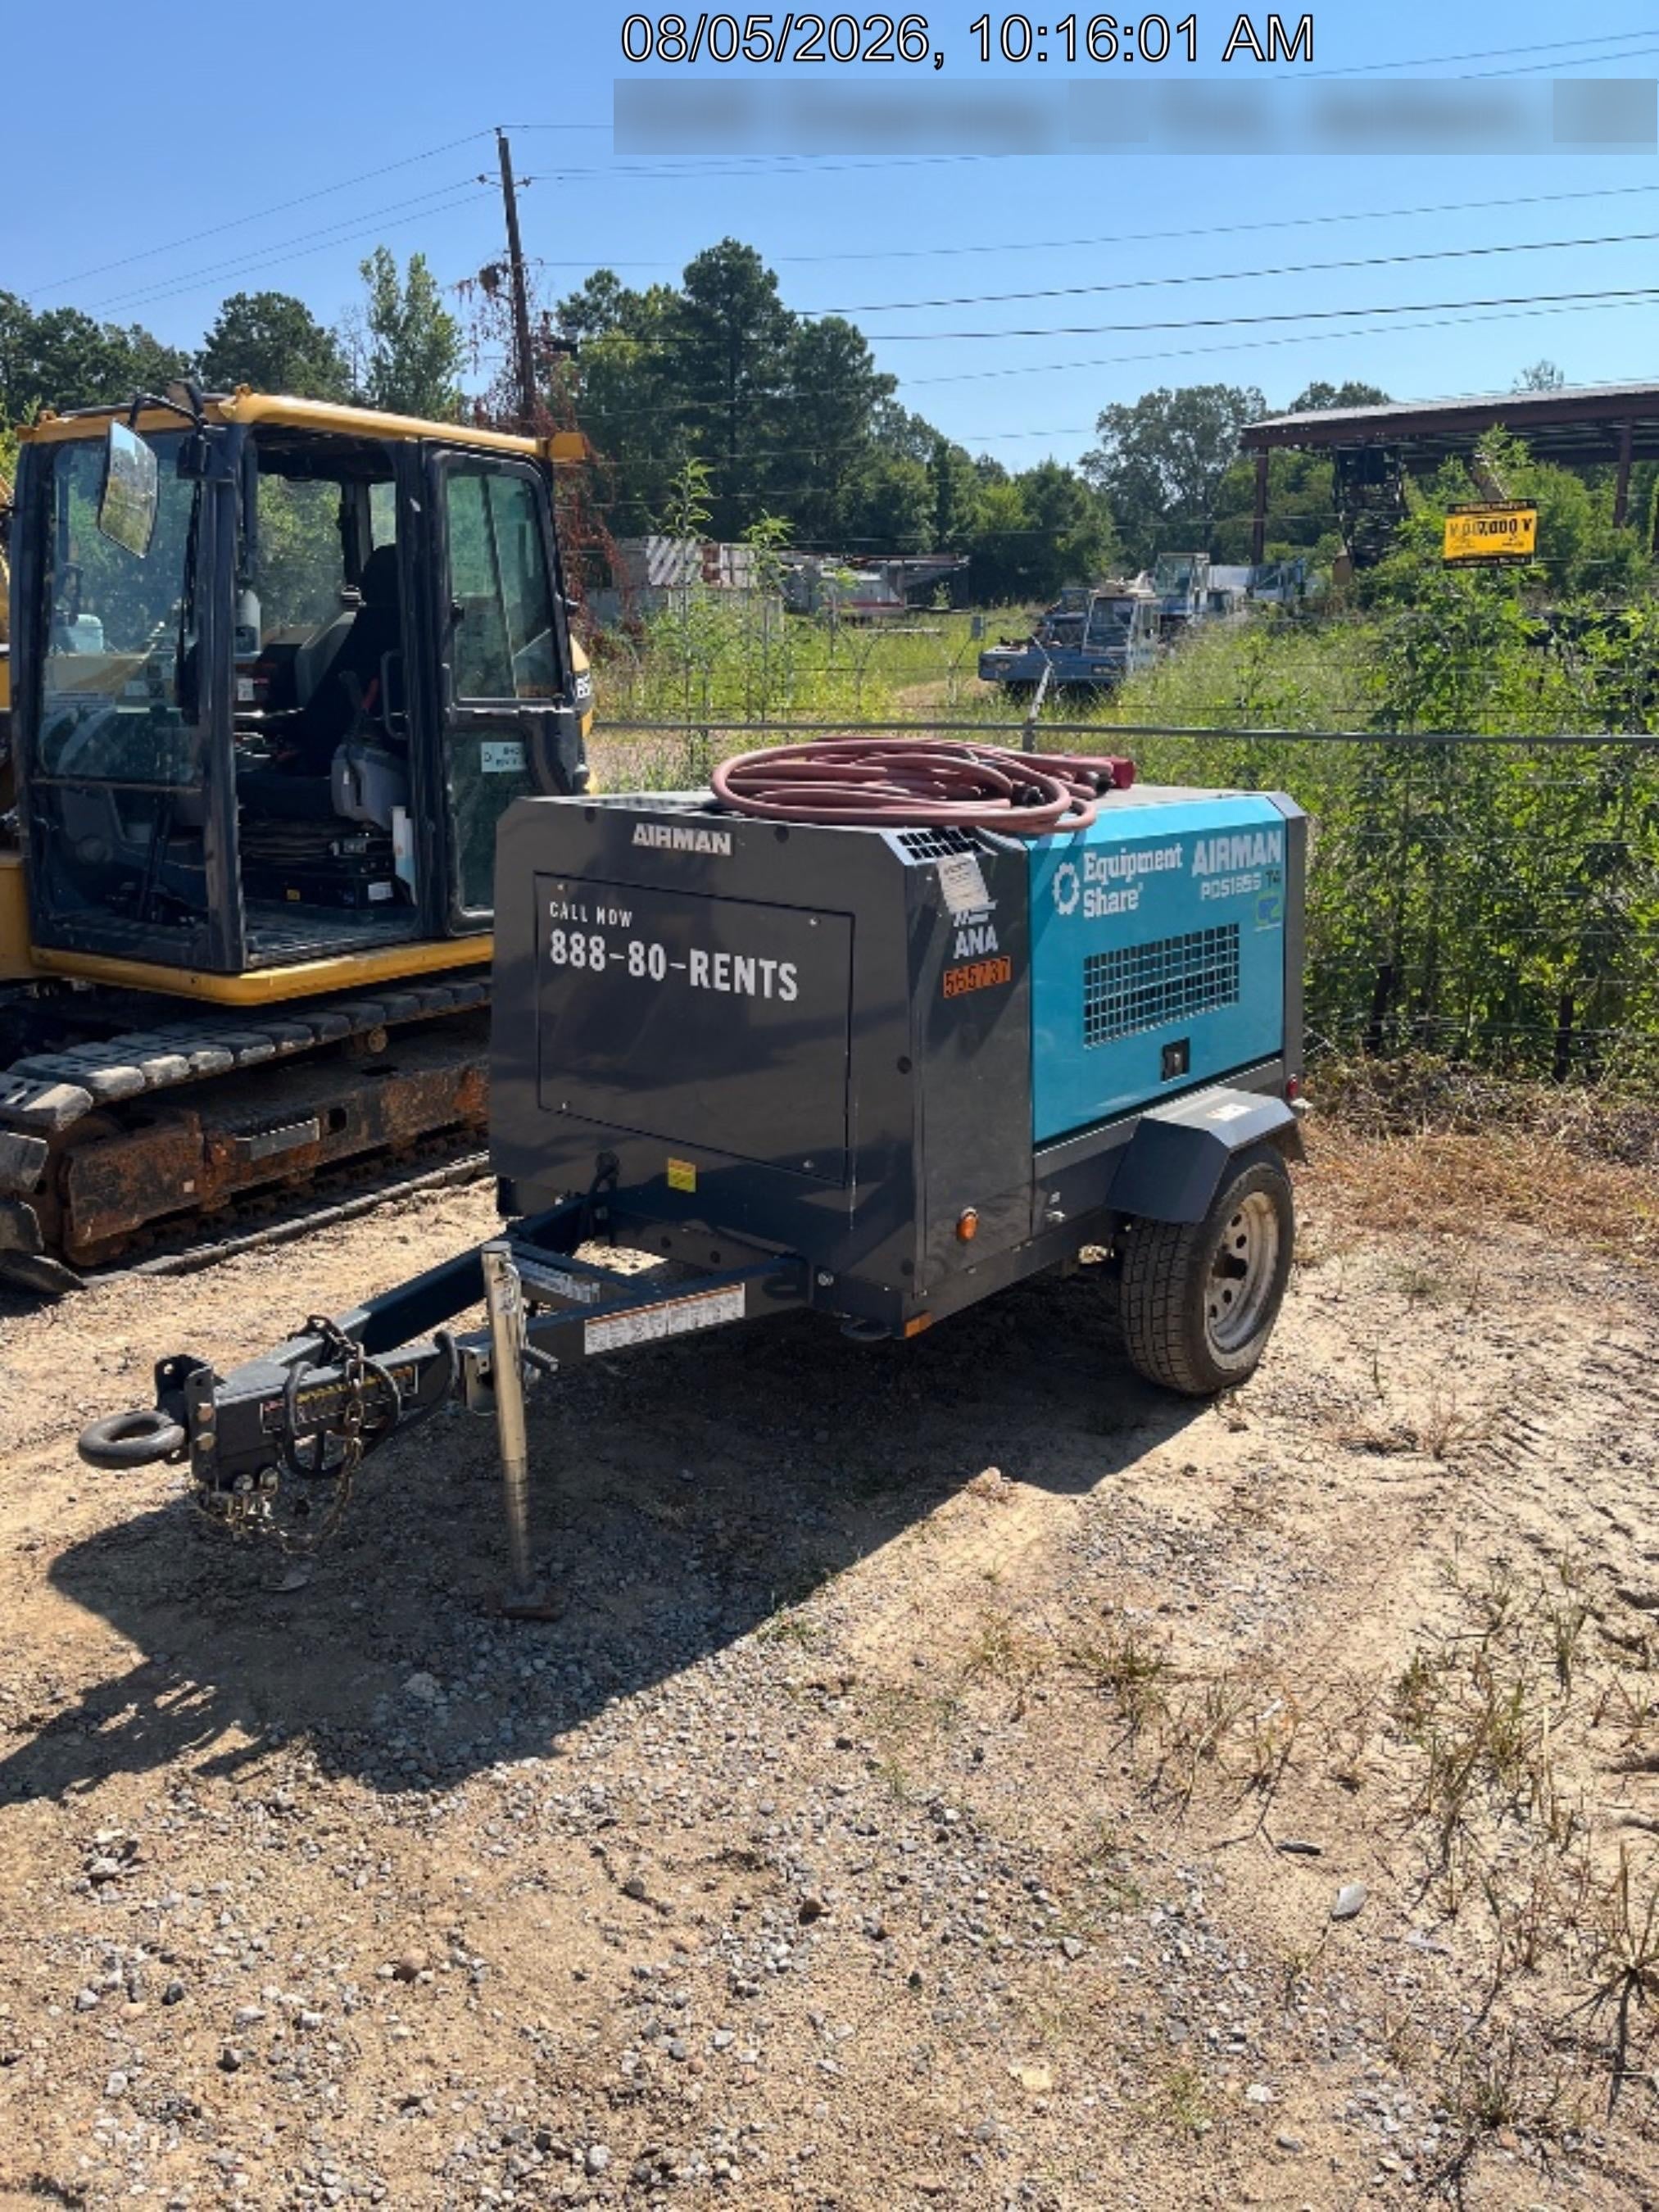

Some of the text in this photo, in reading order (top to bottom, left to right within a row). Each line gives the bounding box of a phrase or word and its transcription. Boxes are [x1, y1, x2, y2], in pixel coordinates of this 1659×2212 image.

[632, 823, 732, 856] AIRMAN
[1191, 830, 1282, 878] AIRMAN
[1083, 842, 1183, 886] Equipment
[550, 901, 632, 927] CALL NOW
[953, 923, 999, 959] ANA
[551, 928, 799, 1001] 888-80-RENTS
